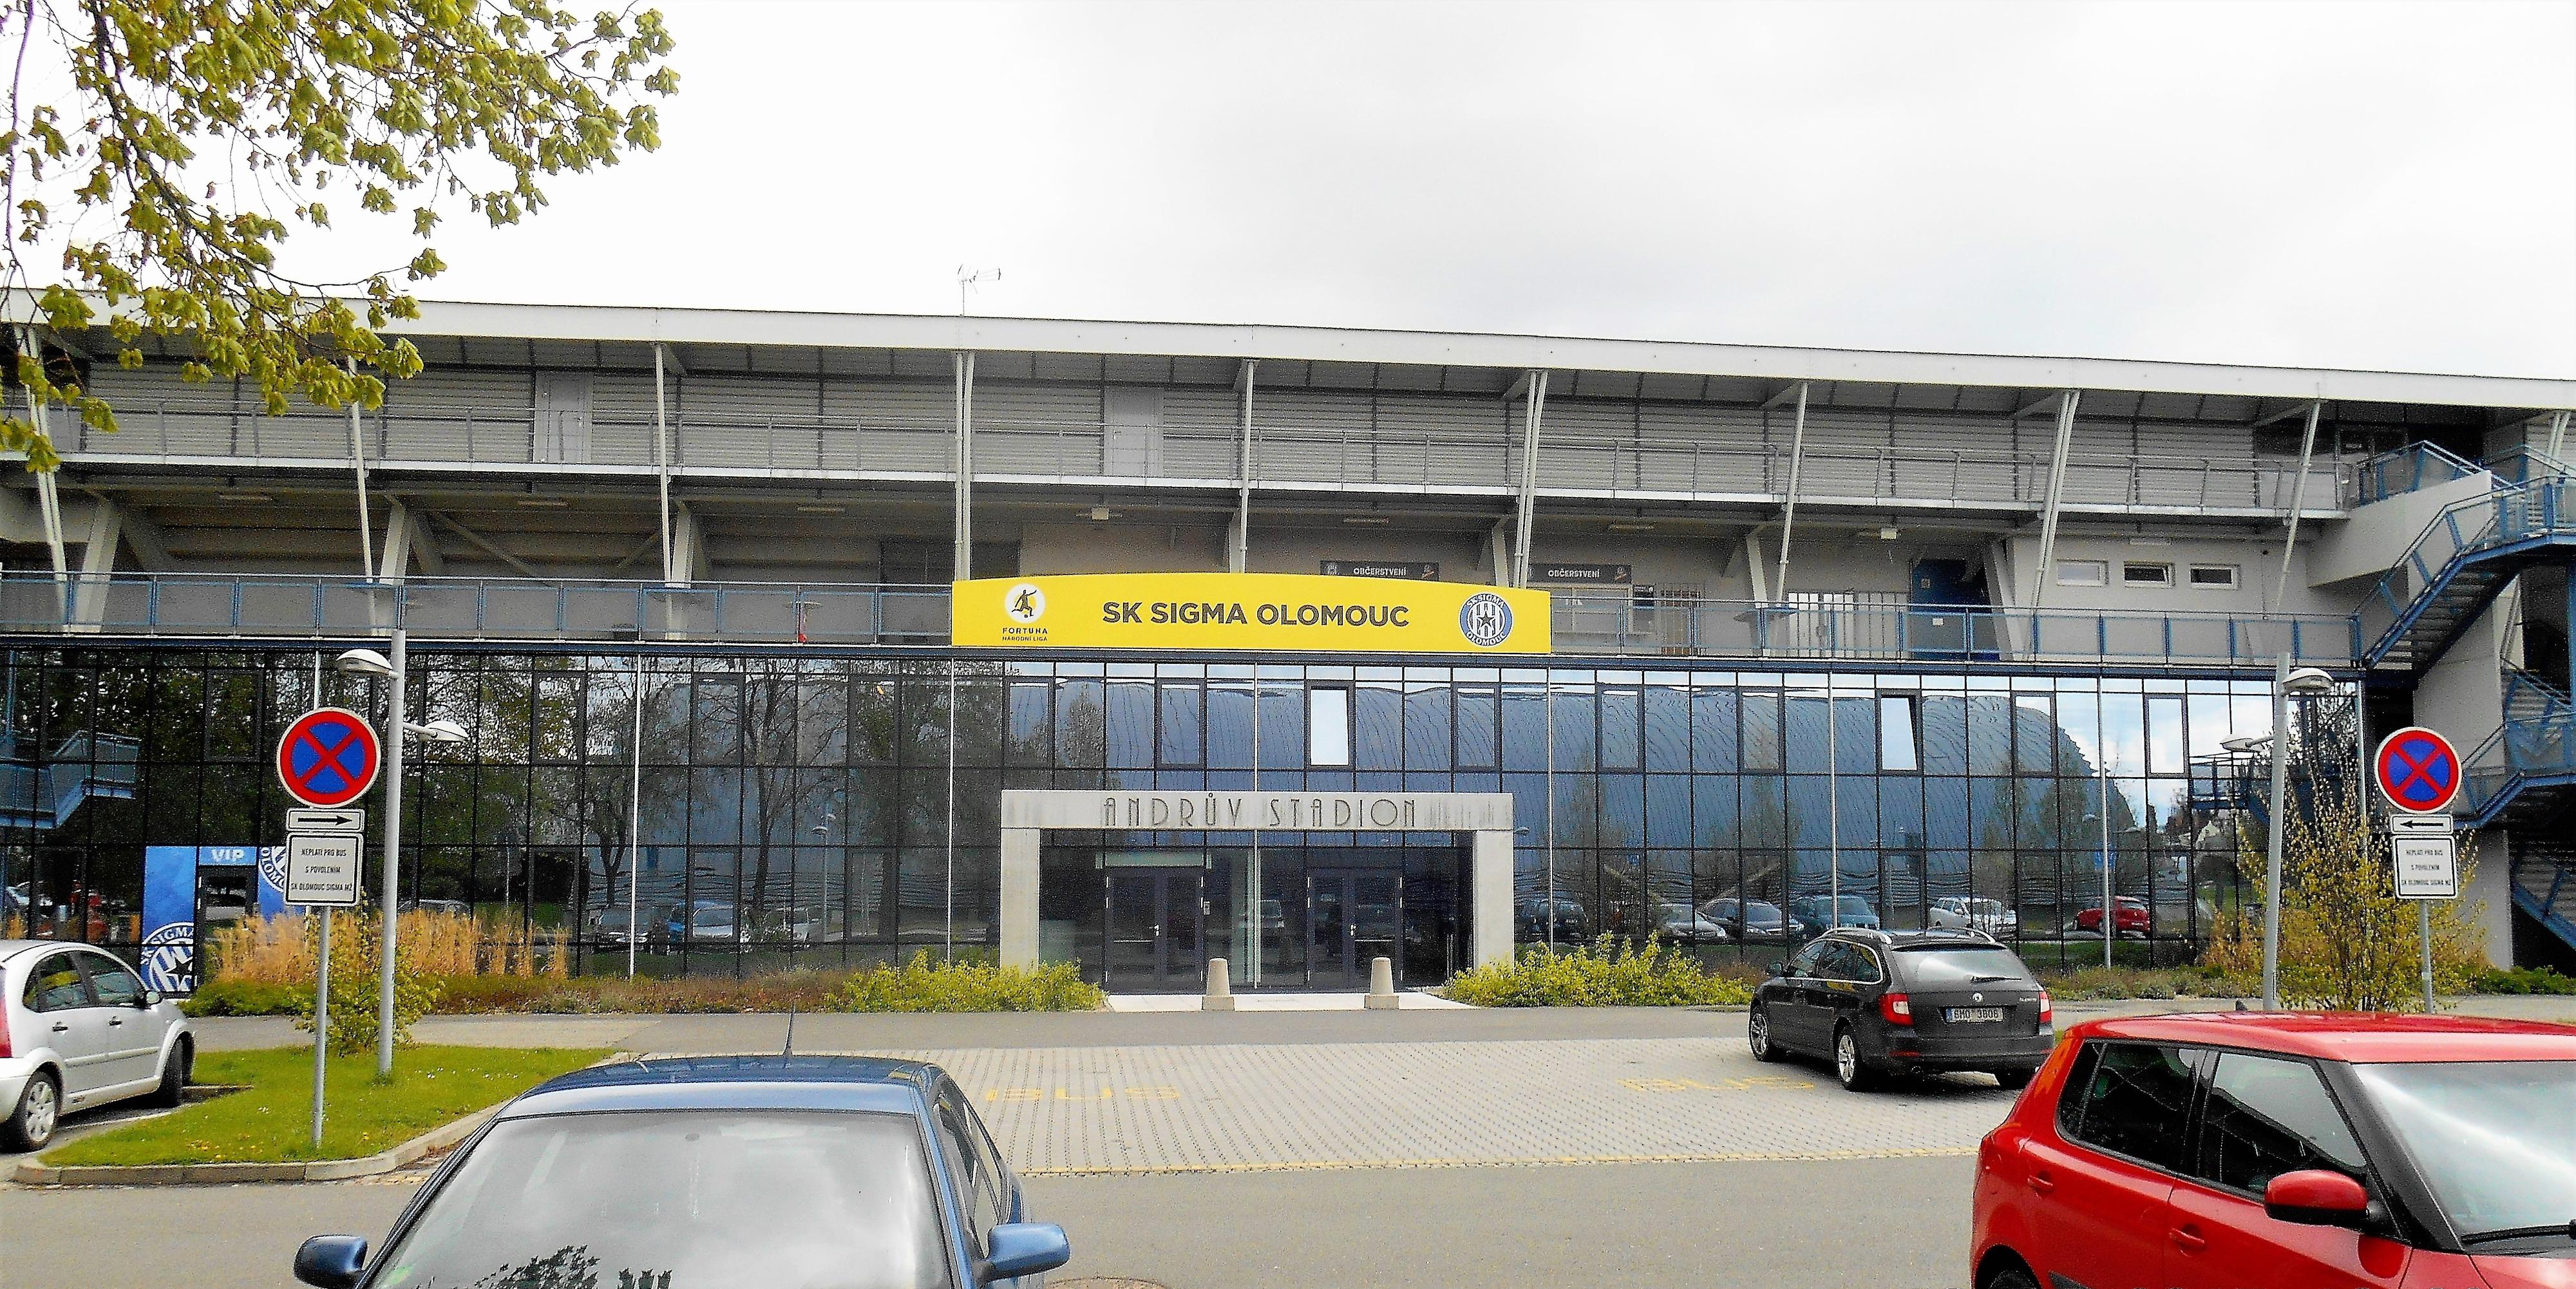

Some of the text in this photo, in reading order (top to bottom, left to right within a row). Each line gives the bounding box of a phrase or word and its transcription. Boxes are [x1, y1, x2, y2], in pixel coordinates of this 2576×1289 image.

[1353, 566, 1406, 576] OBČERSTVENÍ
[1548, 568, 1600, 578] OBČERSTVENÍ
[1466, 594, 1504, 608] SK SIGMA
[1102, 601, 1409, 627] SK SIGMA OLOMOUC
[1466, 631, 1506, 646] OLOMOUC
[1104, 792, 1416, 827] ANDRŮV STADION
[211, 849, 245, 861] VIP
[985, 1086, 1180, 1102] BUS
